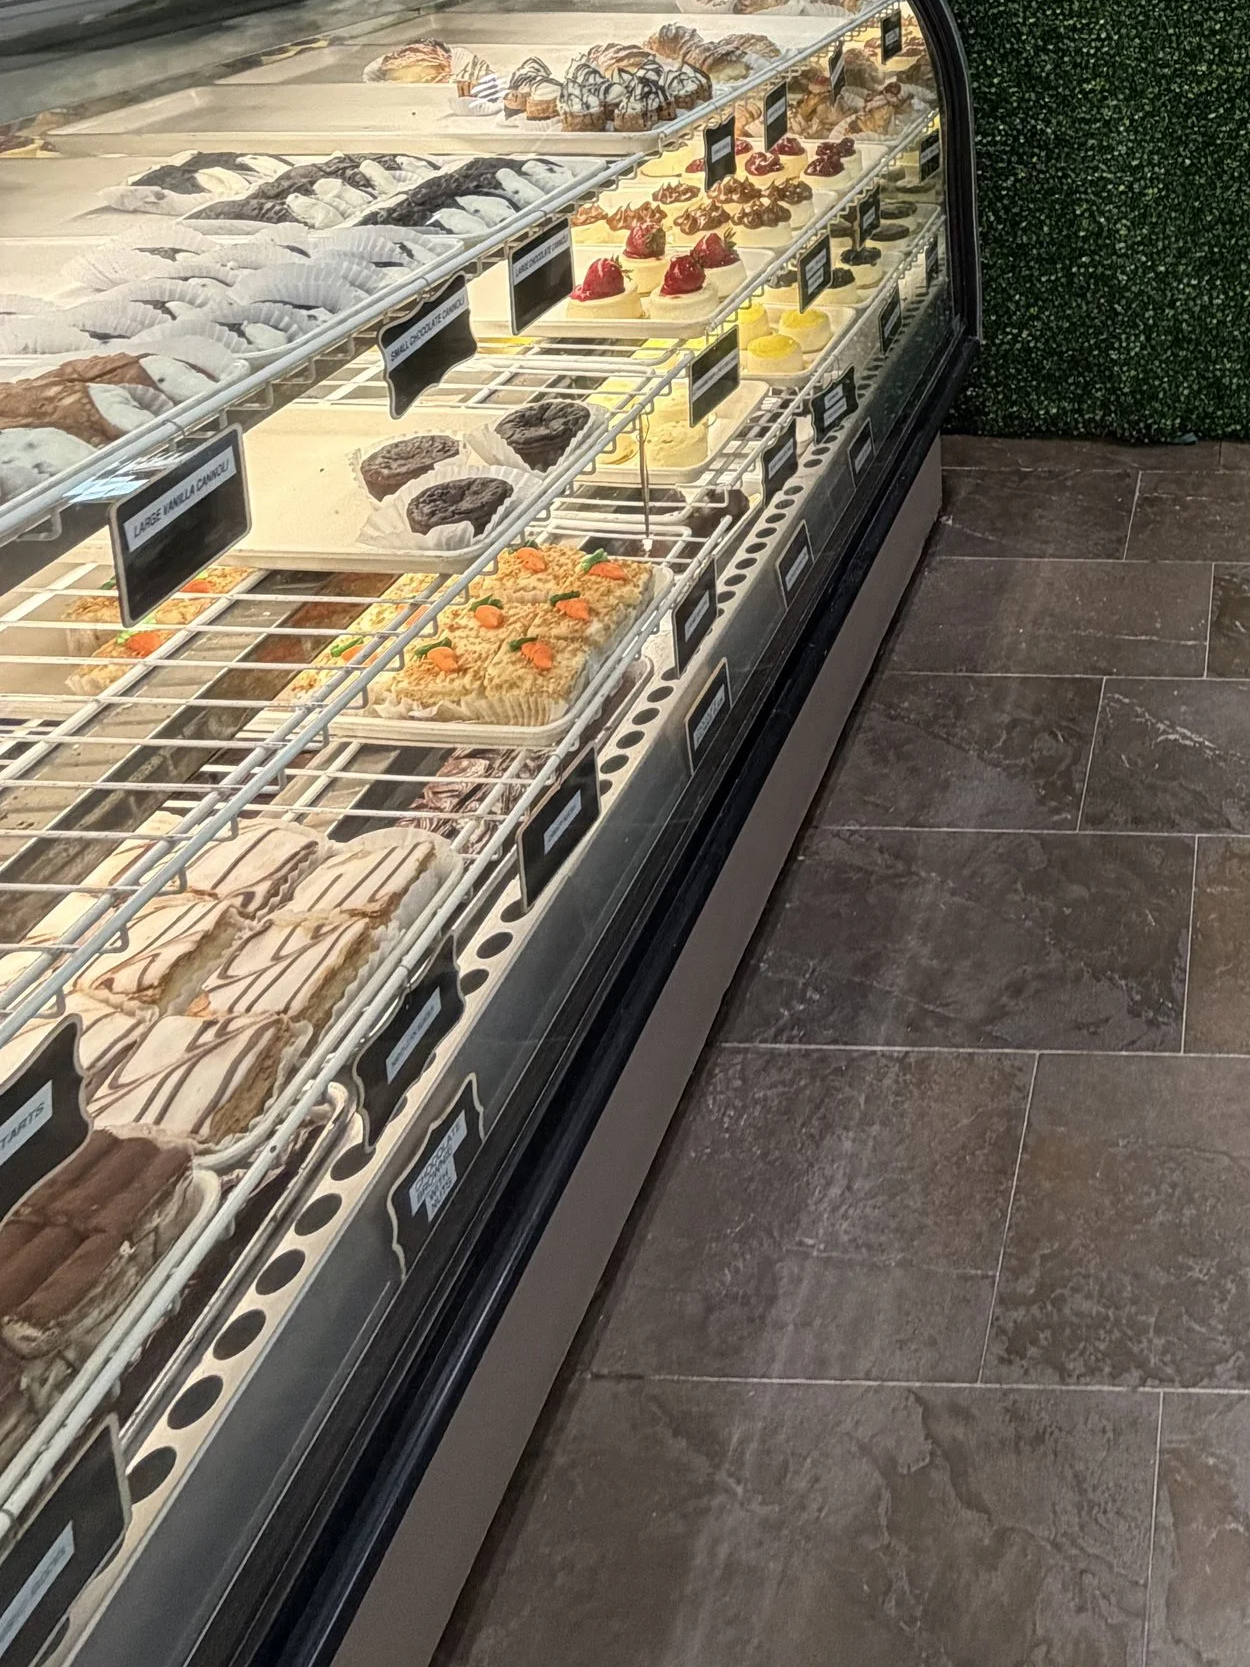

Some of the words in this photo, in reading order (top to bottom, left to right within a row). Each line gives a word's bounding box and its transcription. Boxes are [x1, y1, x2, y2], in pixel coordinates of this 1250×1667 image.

[390, 340, 409, 362] SMALL
[409, 313, 442, 347] CHOCOLATE
[442, 294, 465, 320] CANNOLI
[133, 507, 162, 539] LARGE
[162, 484, 195, 516] VANILLA
[195, 459, 230, 491] CANNOLI
[0, 1101, 45, 1151] TARTS
[415, 1119, 461, 1193] CHOCOLATE
[430, 1166, 450, 1201] WITH
[431, 1175, 453, 1213] NUTS
